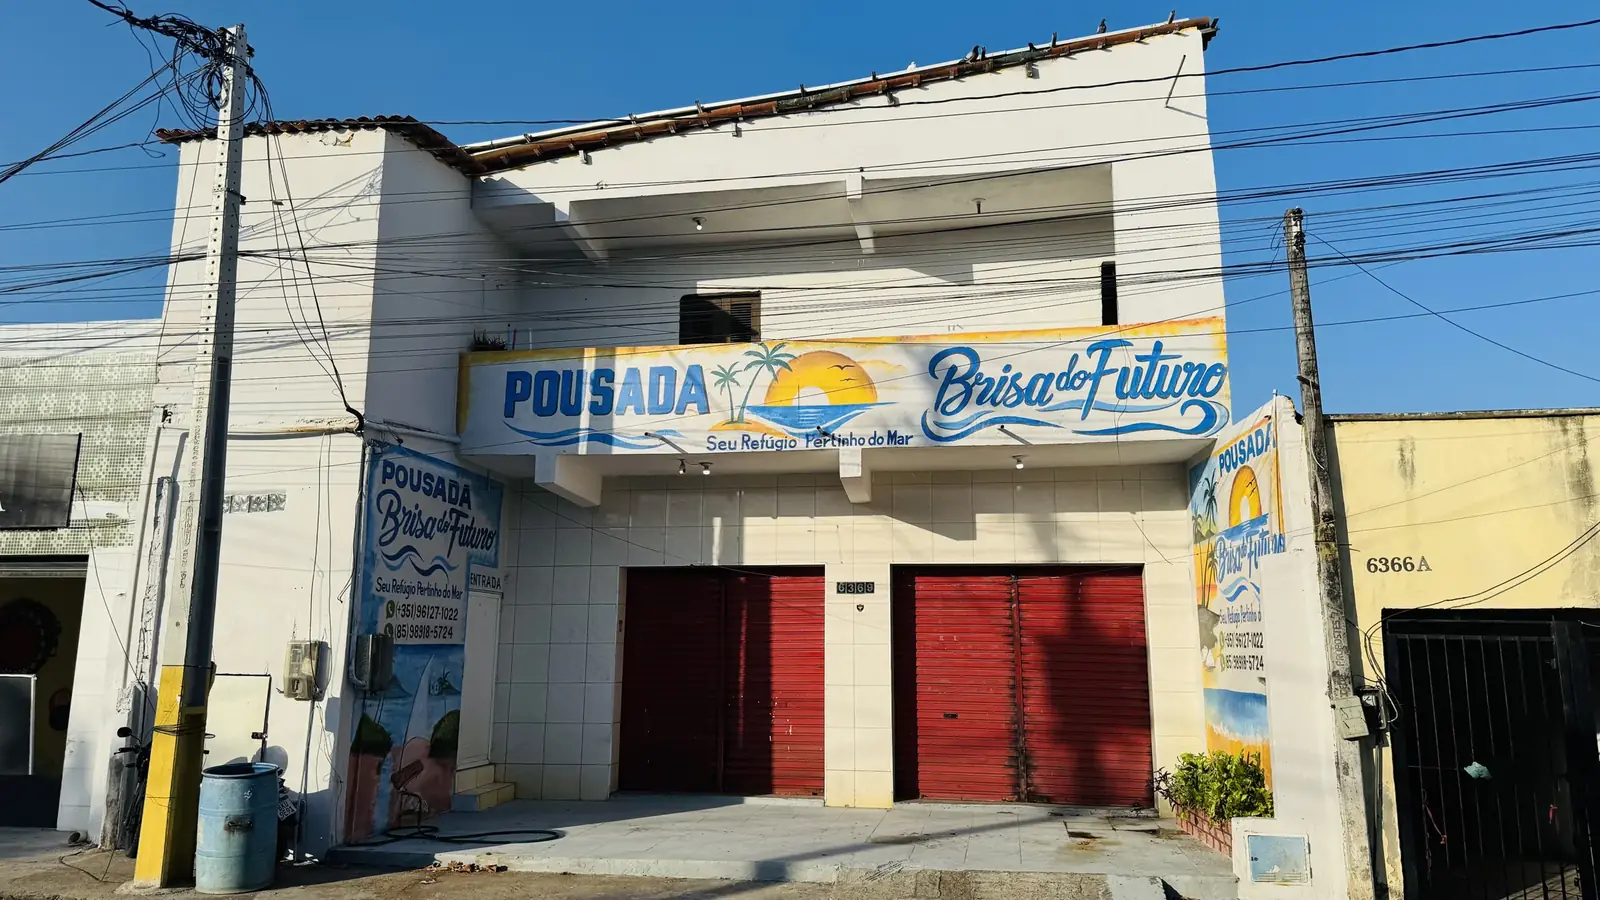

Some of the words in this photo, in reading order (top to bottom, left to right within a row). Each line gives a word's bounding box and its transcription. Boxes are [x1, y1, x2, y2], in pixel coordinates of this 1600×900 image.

[503, 364, 710, 418] POUSADA
[928, 346, 1054, 416] Brisa
[1055, 353, 1090, 391] do
[1080, 339, 1227, 421] Futuro
[706, 435, 737, 451] Seu
[741, 433, 797, 451] Refúgio
[805, 431, 865, 449] Pertinho
[868, 431, 884, 446] do
[886, 430, 914, 446] Mar
[1219, 421, 1277, 477] POUSADA
[382, 459, 471, 510] POUSADA
[376, 489, 437, 547] Brisa
[437, 511, 450, 533] do
[445, 508, 496, 558] Futuro
[1366, 555, 1433, 574] 6366A
[375, 577, 391, 593] Seu
[391, 578, 416, 599] Refúgio
[417, 581, 442, 598] Pertinho
[442, 584, 451, 599] do
[452, 585, 463, 600] Mar
[470, 572, 501, 590] ENTRADA
[838, 583, 873, 593] 6369
[395, 601, 459, 621] (+351)96127-1022
